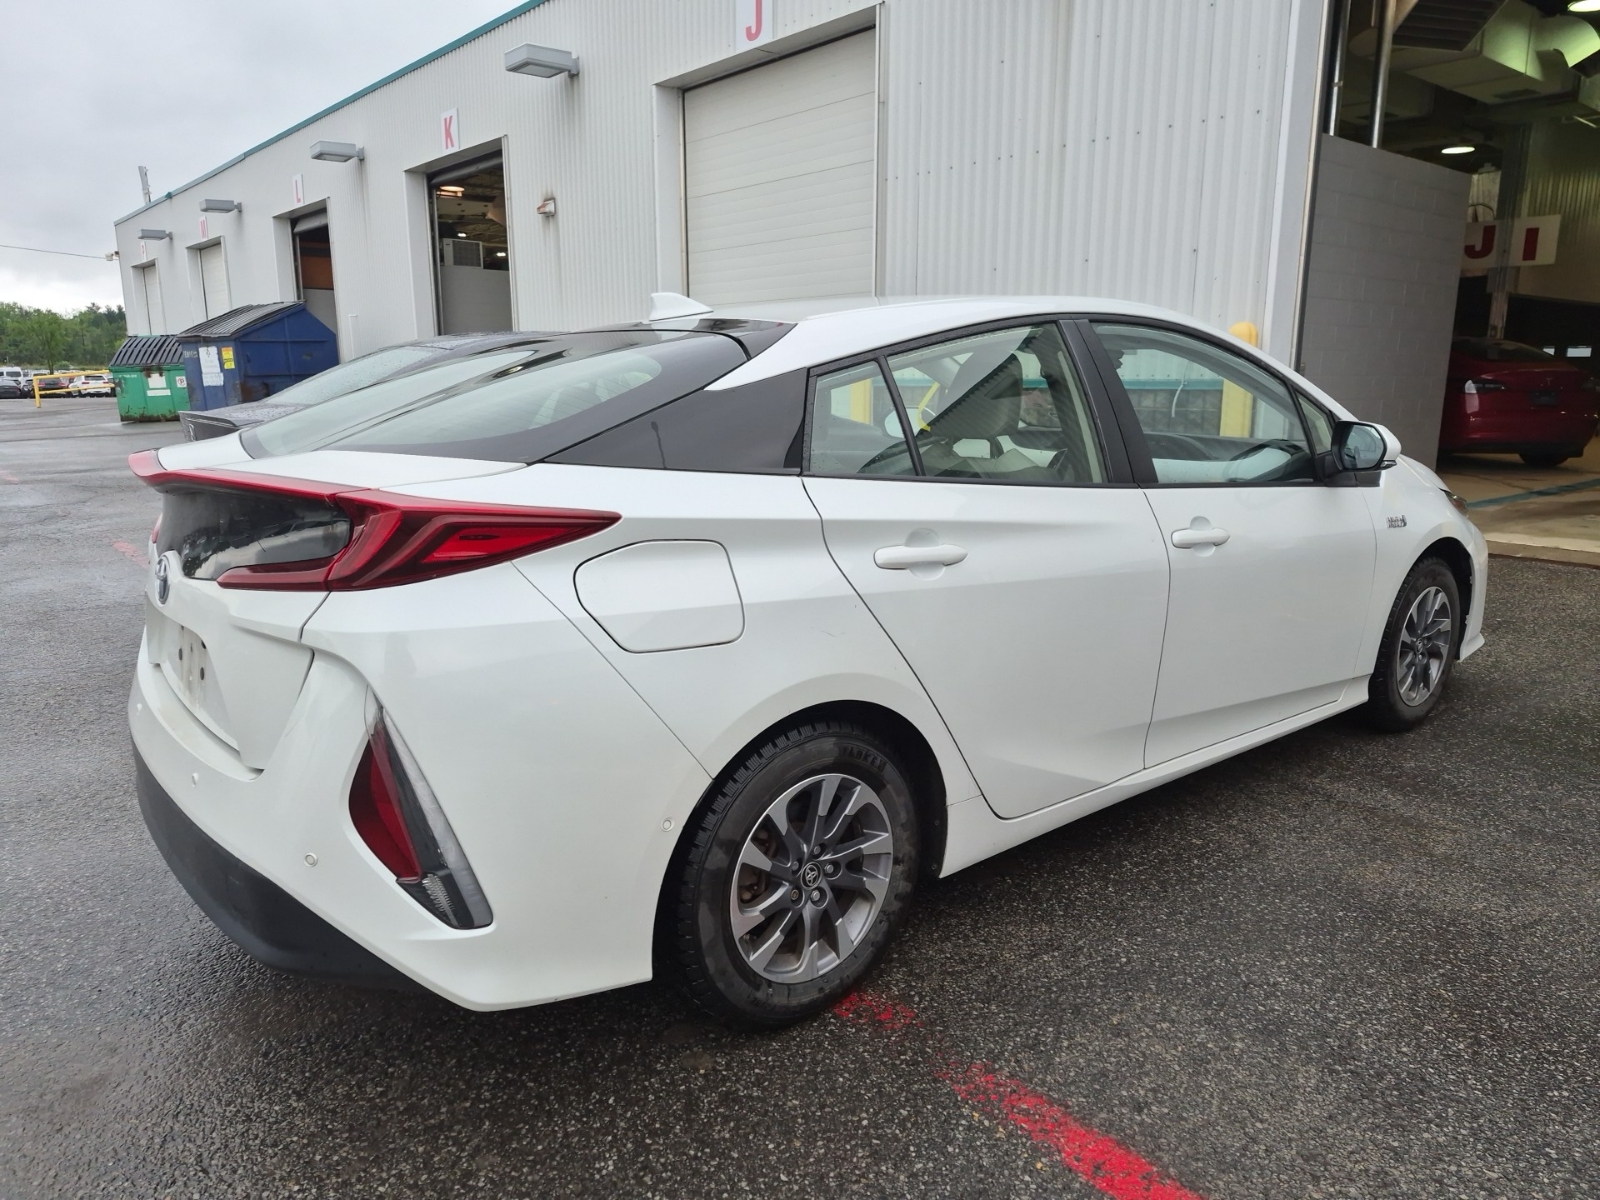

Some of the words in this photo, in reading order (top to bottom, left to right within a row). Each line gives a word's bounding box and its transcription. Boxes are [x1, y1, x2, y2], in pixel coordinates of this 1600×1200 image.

[745, 0, 763, 42] J
[444, 115, 455, 150] K
[295, 179, 302, 204] L
[1464, 225, 1496, 259] J
[1522, 227, 1540, 261] I
